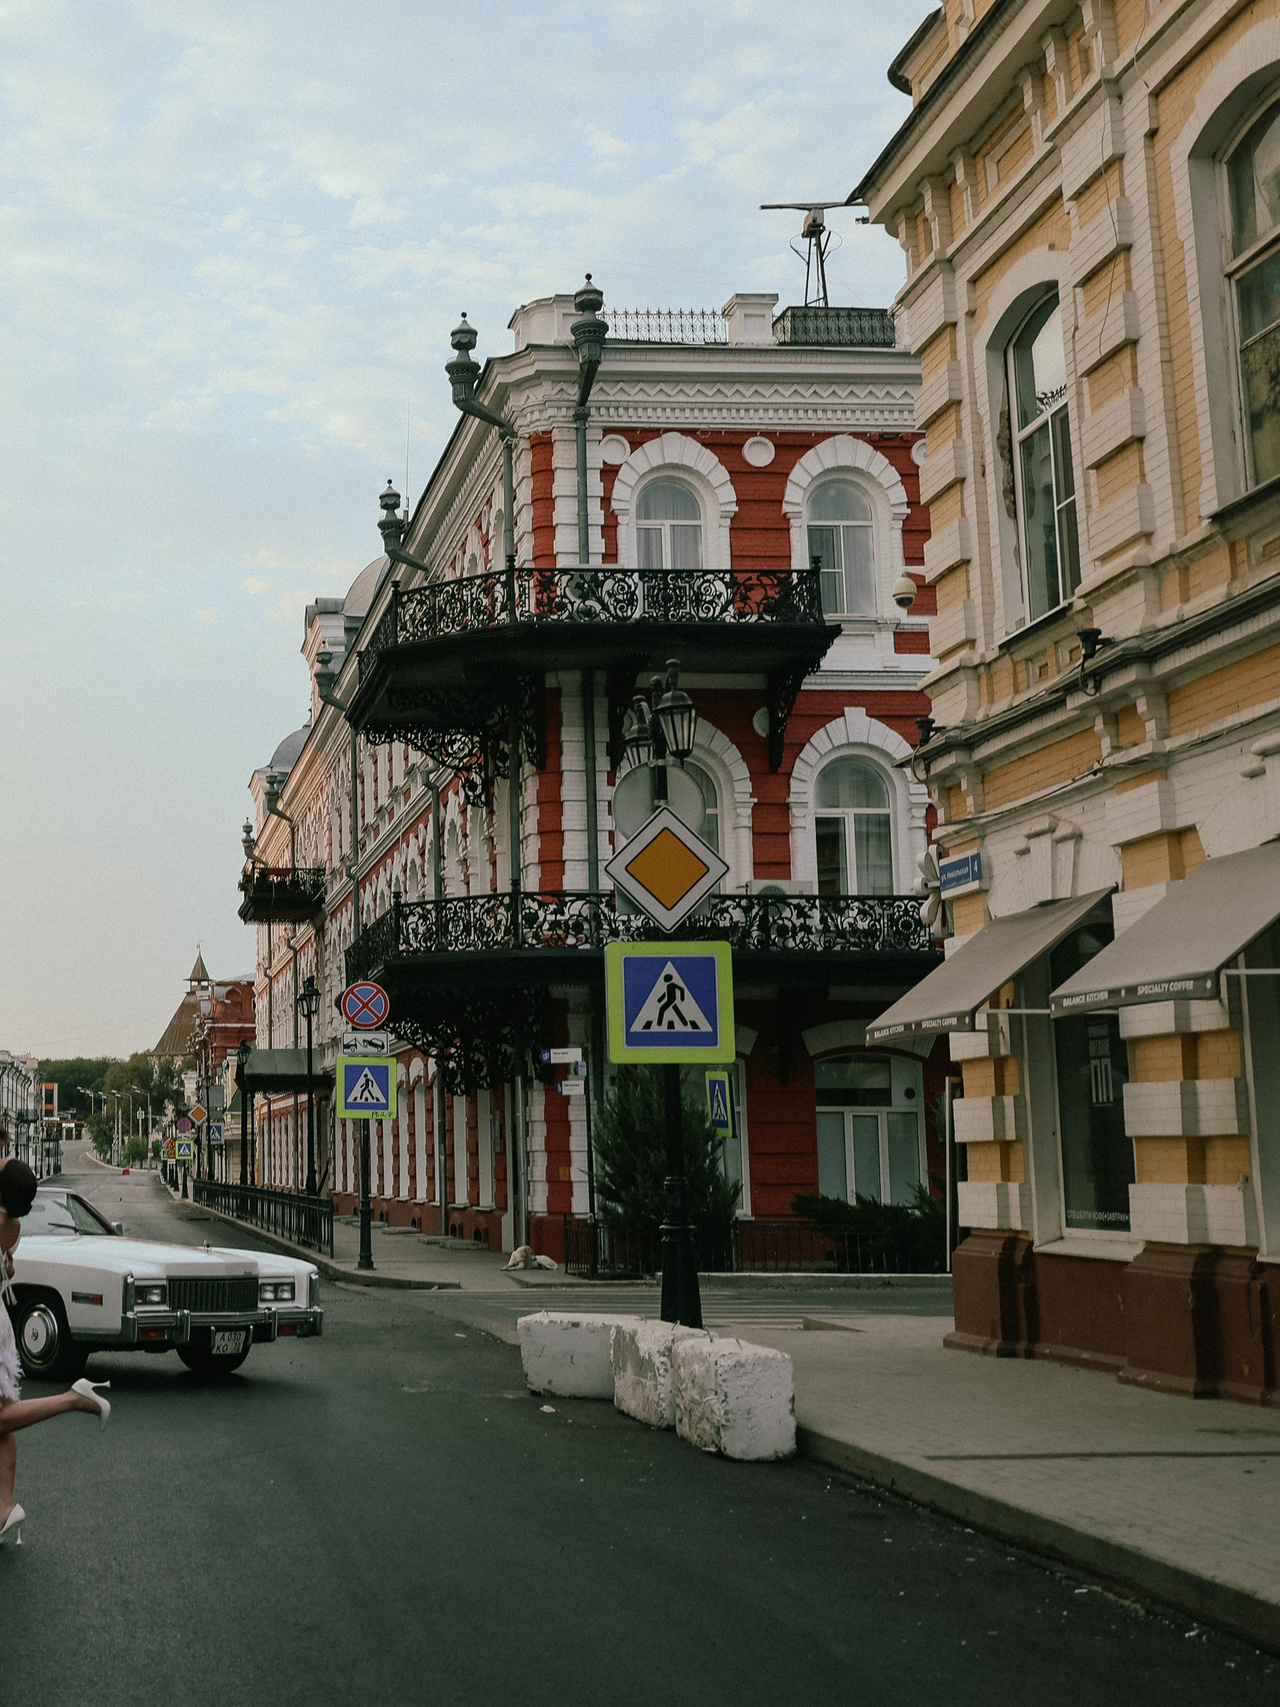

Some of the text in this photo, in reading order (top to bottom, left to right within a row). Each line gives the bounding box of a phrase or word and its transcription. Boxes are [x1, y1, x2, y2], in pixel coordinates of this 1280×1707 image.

[947, 866, 969, 879] Никольская
[973, 860, 978, 873] 4
[1062, 980, 1194, 1008] BALANCE KITCHEN SPECIALTY COFFEE
[921, 1018, 942, 1029] SPECIALTY
[942, 1017, 958, 1027] COFFEE
